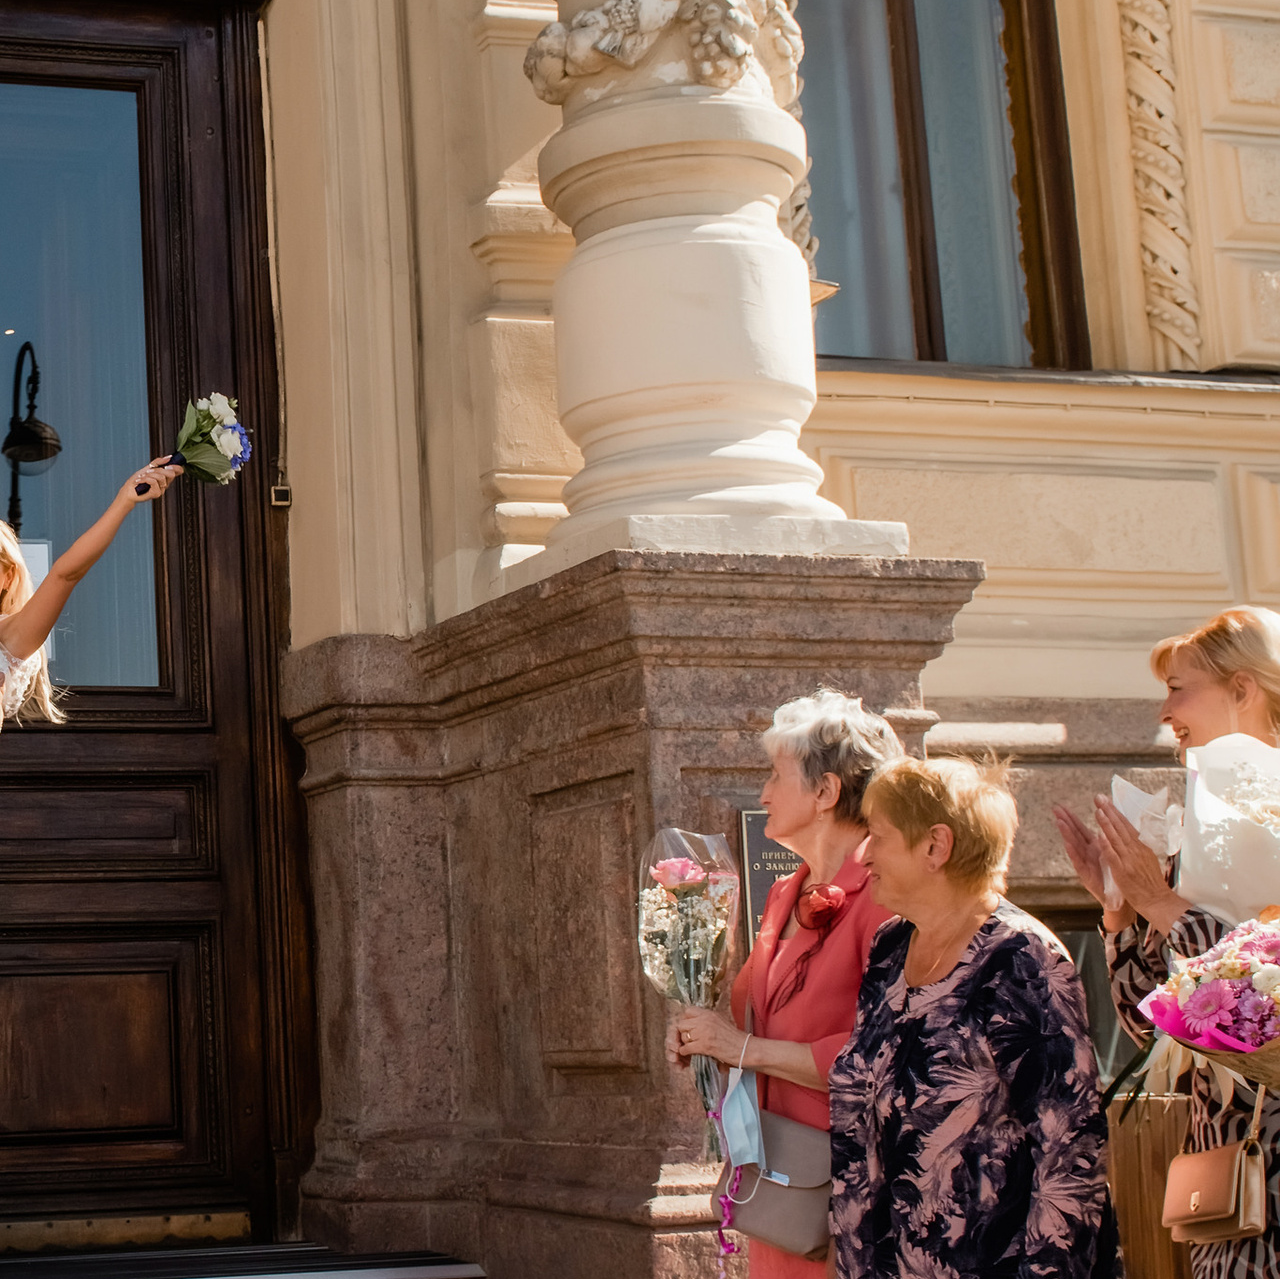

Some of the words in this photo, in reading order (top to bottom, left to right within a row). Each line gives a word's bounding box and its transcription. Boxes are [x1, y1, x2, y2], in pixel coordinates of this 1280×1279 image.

[761, 851, 796, 860] ПРИЕМ
[753, 862, 761, 871] О
[765, 862, 802, 871] ЗАКЛЮ
